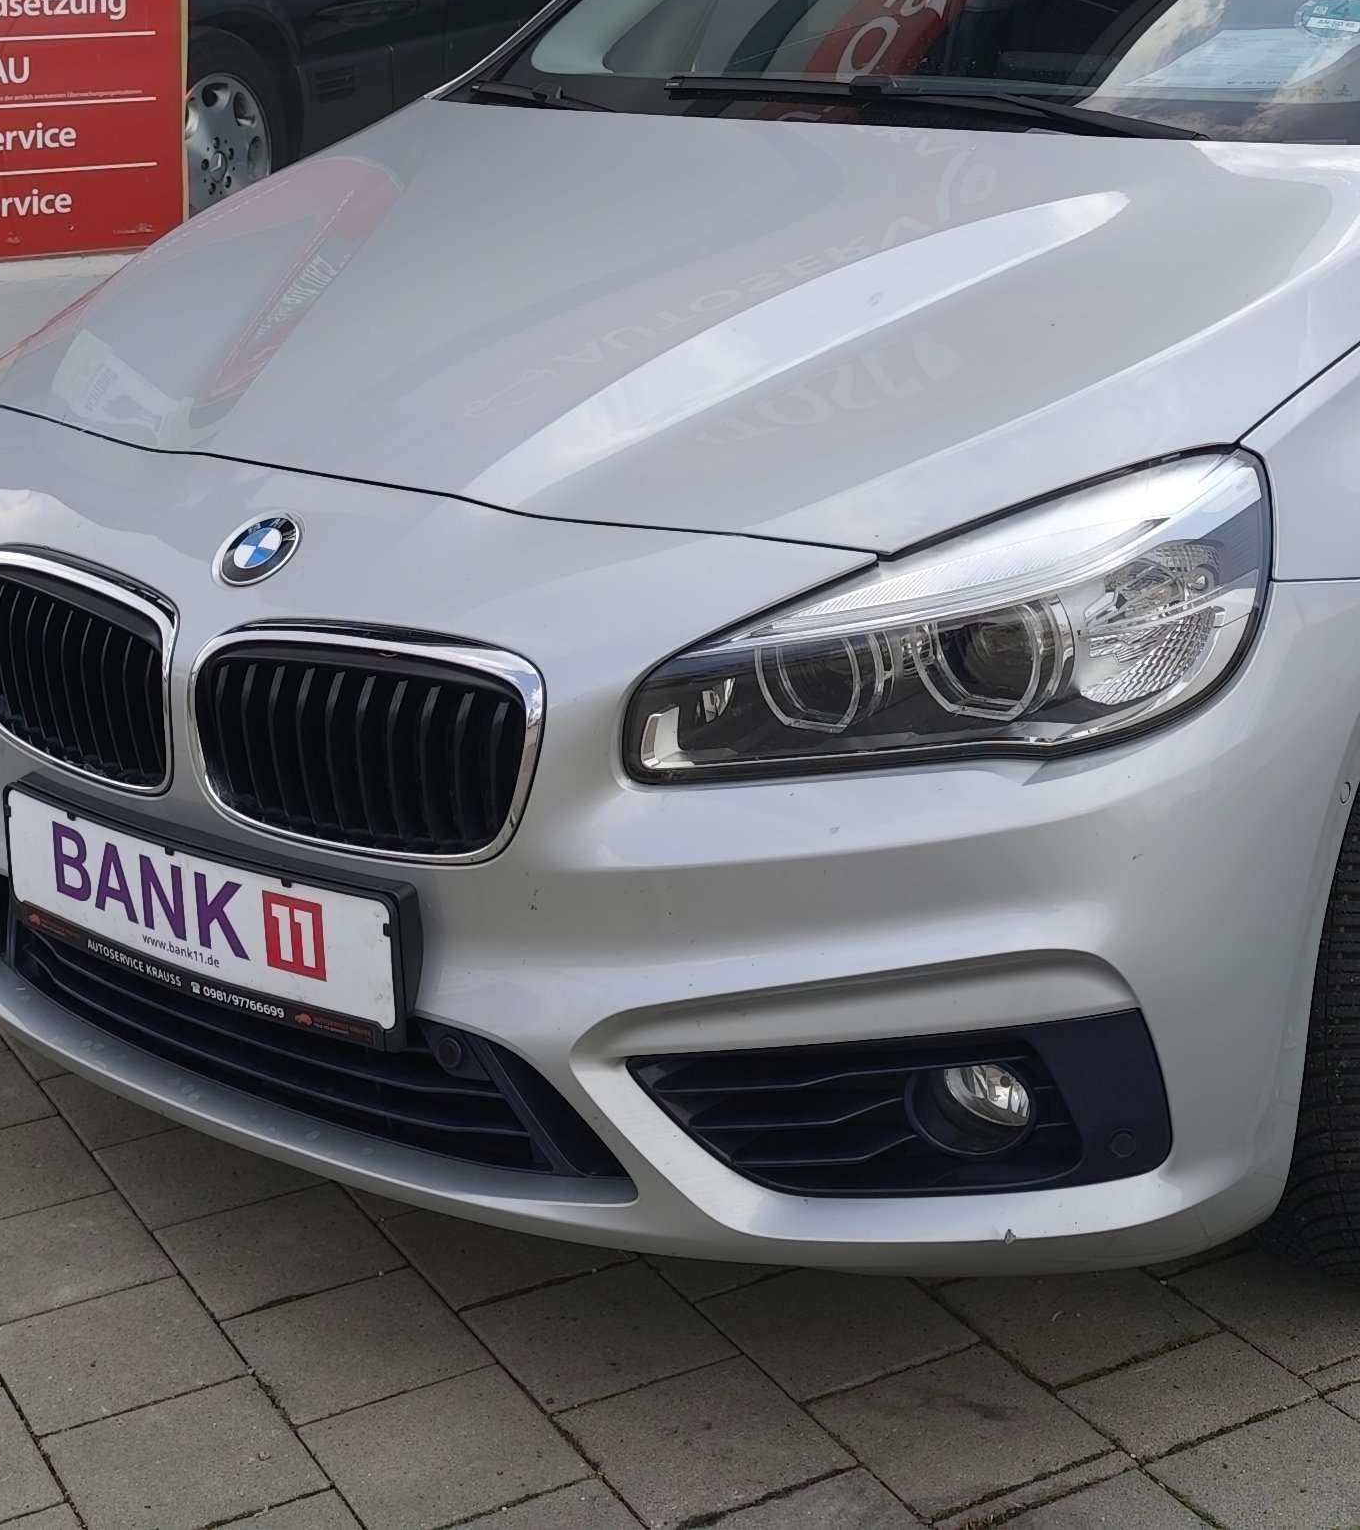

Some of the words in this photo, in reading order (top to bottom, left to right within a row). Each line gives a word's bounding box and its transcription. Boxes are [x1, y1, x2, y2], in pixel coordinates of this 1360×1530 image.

[52, 820, 250, 961] BANK
[270, 903, 316, 969] 11
[87, 939, 145, 973] AUTOSERVICE
[145, 964, 182, 987] KRAUSS
[203, 986, 285, 1020] 0981/97766699
[141, 933, 220, 969] www.bank11.de
